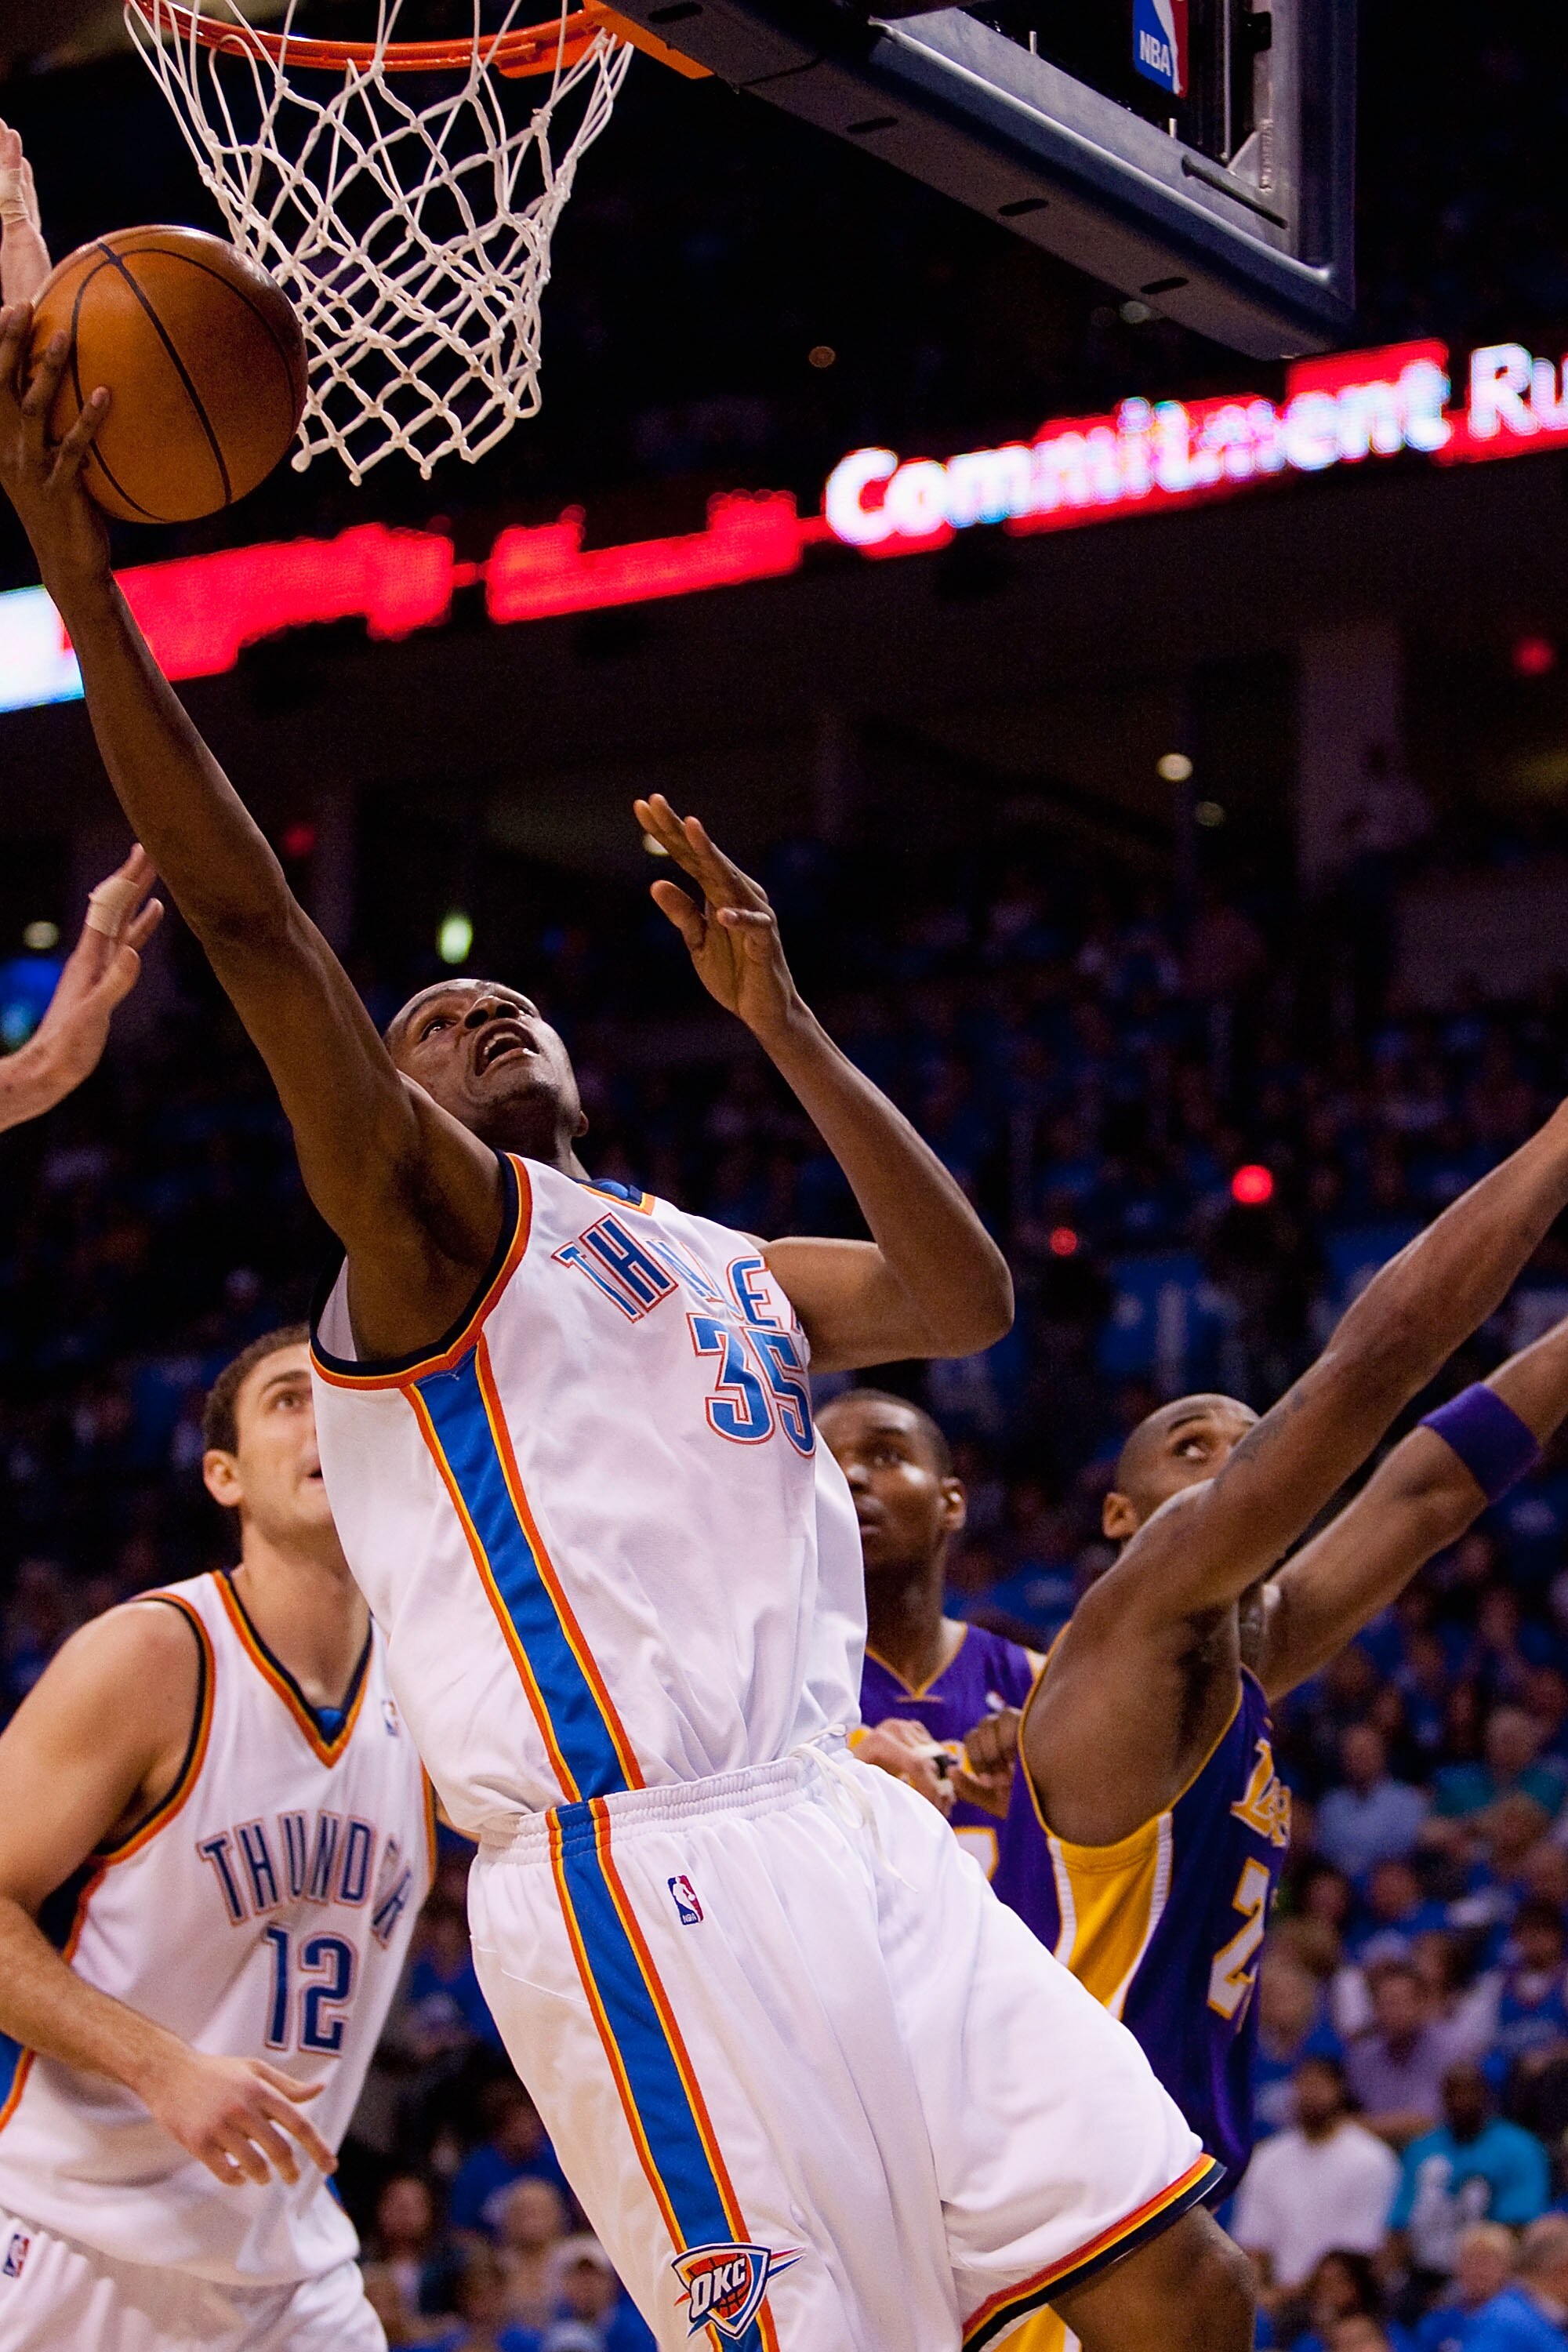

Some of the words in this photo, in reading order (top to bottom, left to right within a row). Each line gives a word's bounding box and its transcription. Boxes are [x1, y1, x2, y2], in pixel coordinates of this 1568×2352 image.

[1139, 29, 1172, 77] NBA
[685, 1312, 816, 1460] 35
[264, 1920, 360, 2059] 12
[690, 2257, 746, 2320] OKC
